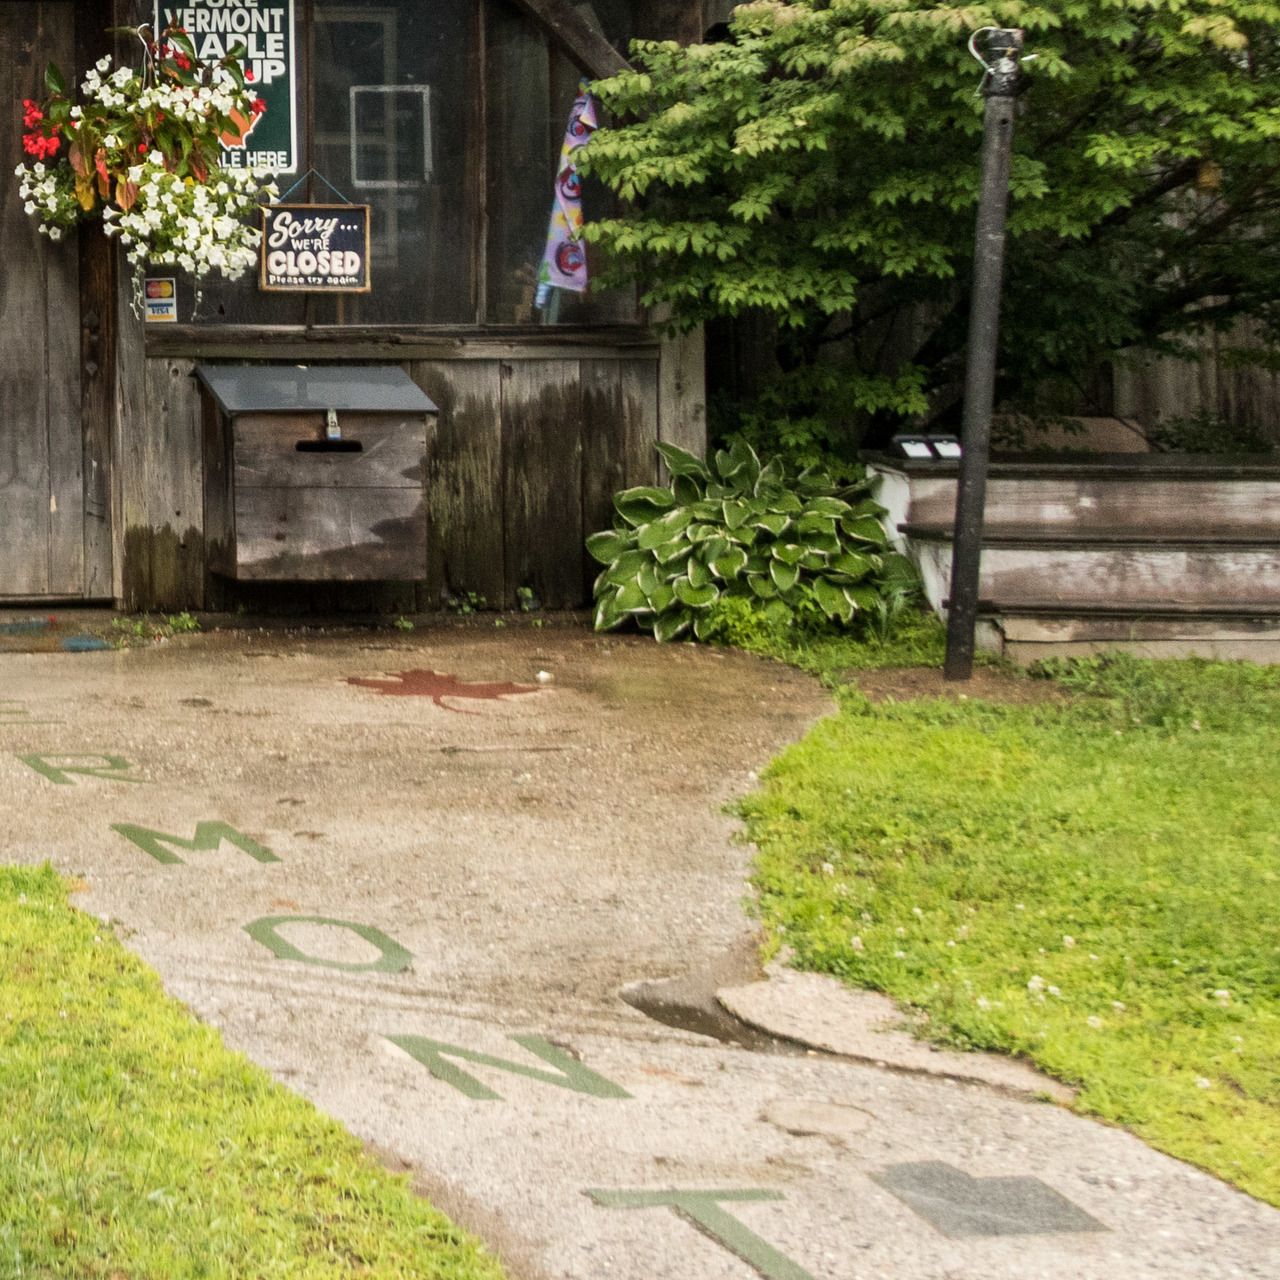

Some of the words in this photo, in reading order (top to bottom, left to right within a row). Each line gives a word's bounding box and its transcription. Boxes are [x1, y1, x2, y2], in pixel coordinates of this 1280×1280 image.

[164, 8, 284, 33] VERMONT
[246, 151, 288, 168] HERE
[291, 239, 330, 251] WE'RE
[267, 250, 360, 276] CLOSED
[269, 274, 304, 284] Please
[307, 275, 323, 284] try
